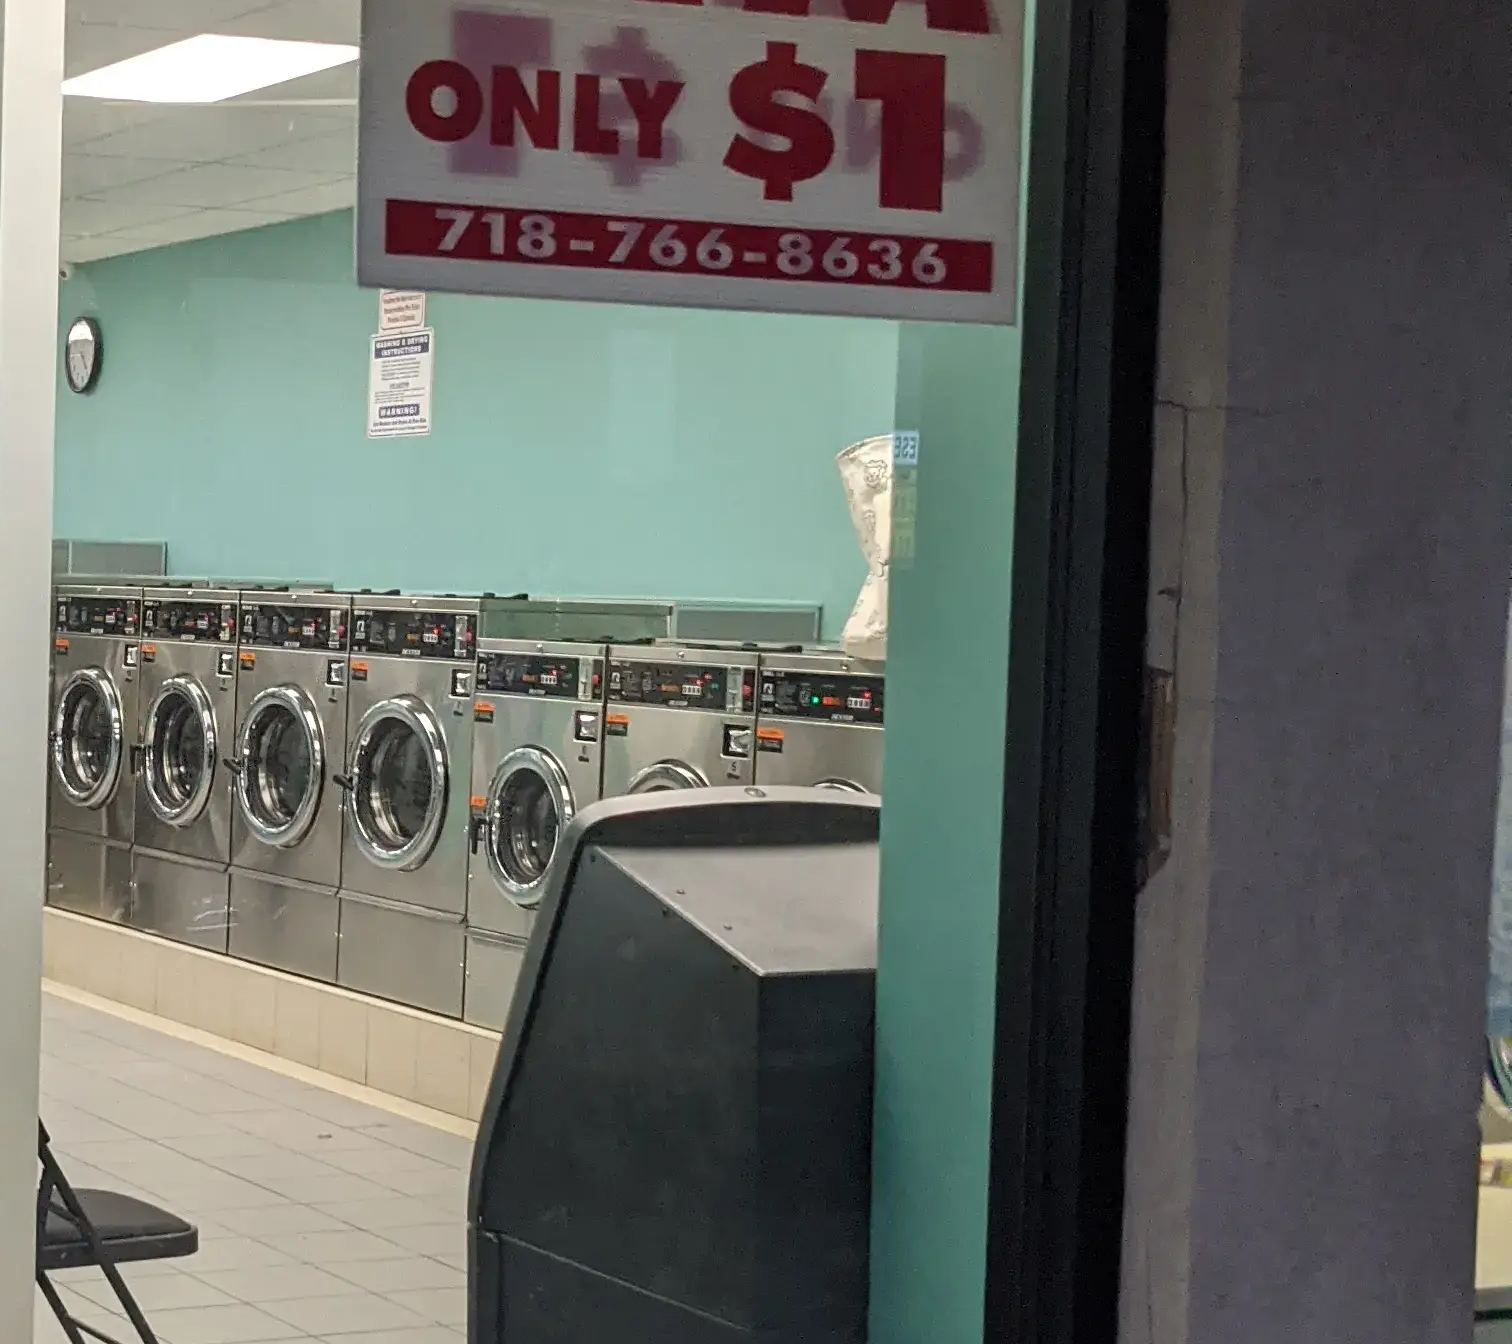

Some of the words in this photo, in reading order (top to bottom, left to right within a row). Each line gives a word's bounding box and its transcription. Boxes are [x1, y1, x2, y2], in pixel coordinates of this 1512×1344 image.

[405, 59, 686, 159] ONLY
[722, 40, 947, 213] $1
[435, 207, 948, 285] 718-766-8636
